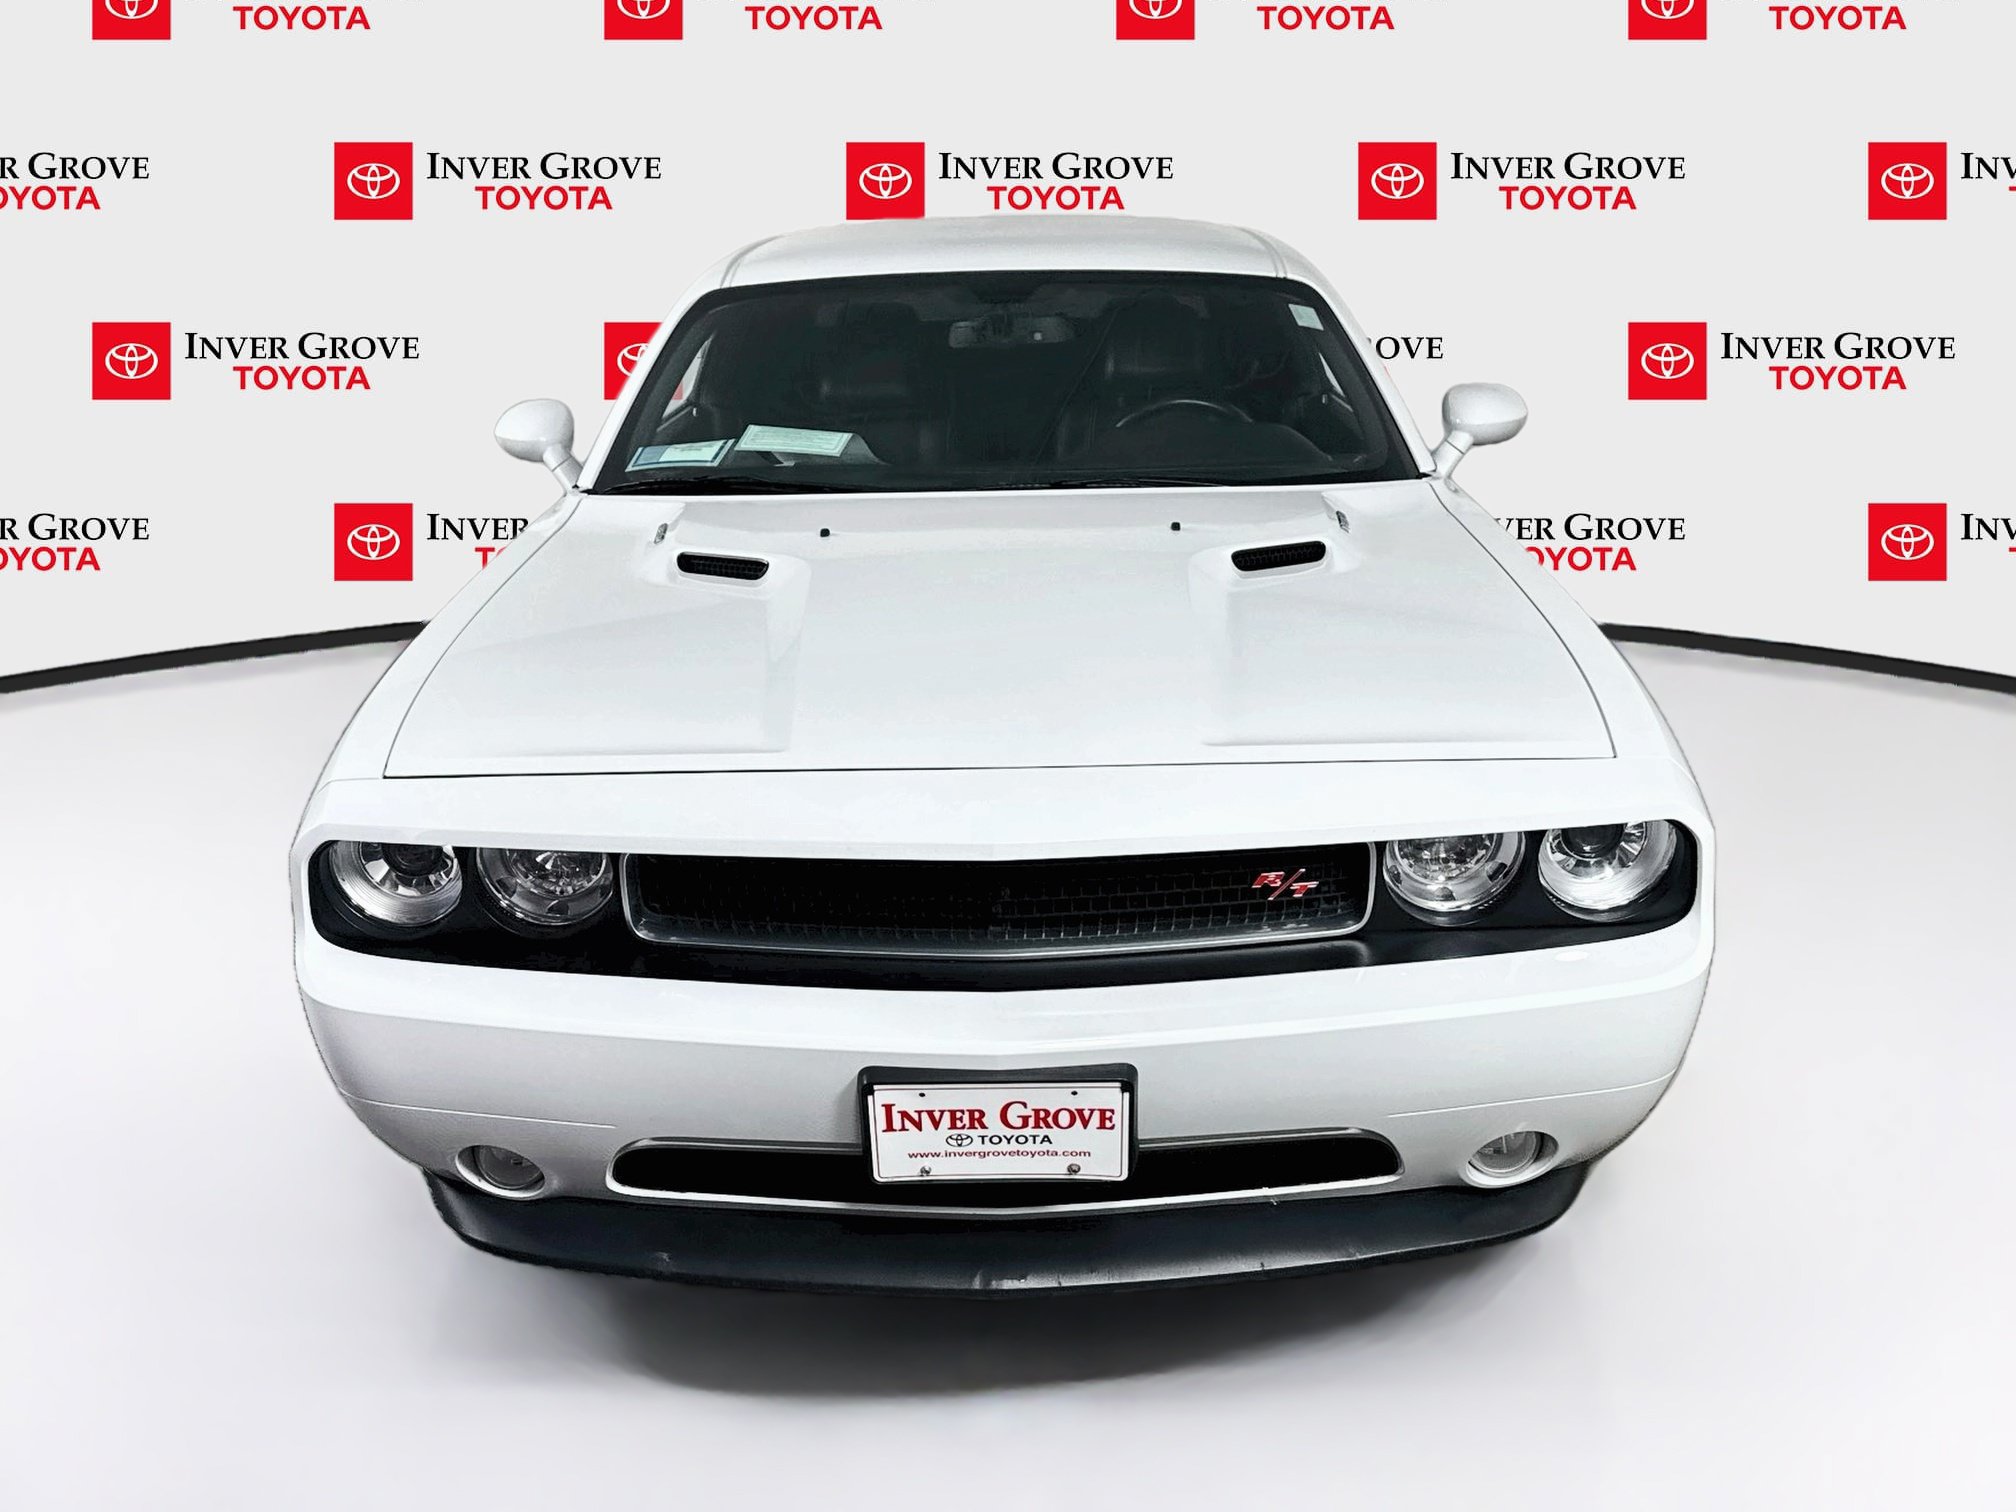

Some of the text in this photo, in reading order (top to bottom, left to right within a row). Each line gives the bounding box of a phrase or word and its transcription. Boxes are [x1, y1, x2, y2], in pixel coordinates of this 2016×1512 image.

[232, 4, 371, 31] TOYOTA
[744, 4, 883, 31] TOYOTA
[1256, 4, 1395, 31] TOYOTA
[1768, 4, 1907, 31] TOYOTA
[28, 152, 149, 180] GROVE
[427, 152, 662, 180] INVER GROVE
[939, 152, 1174, 180] INVER GROVE
[1451, 152, 1686, 180] INVER GROVE
[473, 185, 612, 211] TOYOTA
[985, 185, 1124, 211] TOYOTA
[1497, 185, 1636, 211] TOYOTA
[184, 332, 419, 360] INVER GROVE
[1367, 336, 1444, 360] OVE
[1720, 332, 1955, 360] INVER GROVE
[231, 365, 370, 391] TOYOTA
[1767, 365, 1906, 391] TOYOTA
[28, 513, 149, 541] GROVE
[1564, 513, 1686, 541] GROVE
[1251, 868, 1320, 900] R/T
[881, 1100, 1116, 1132] INVER GROVE
[907, 1148, 1092, 1159] www.invergrovetoyota.com
[977, 1134, 1053, 1146] TOYOTA
